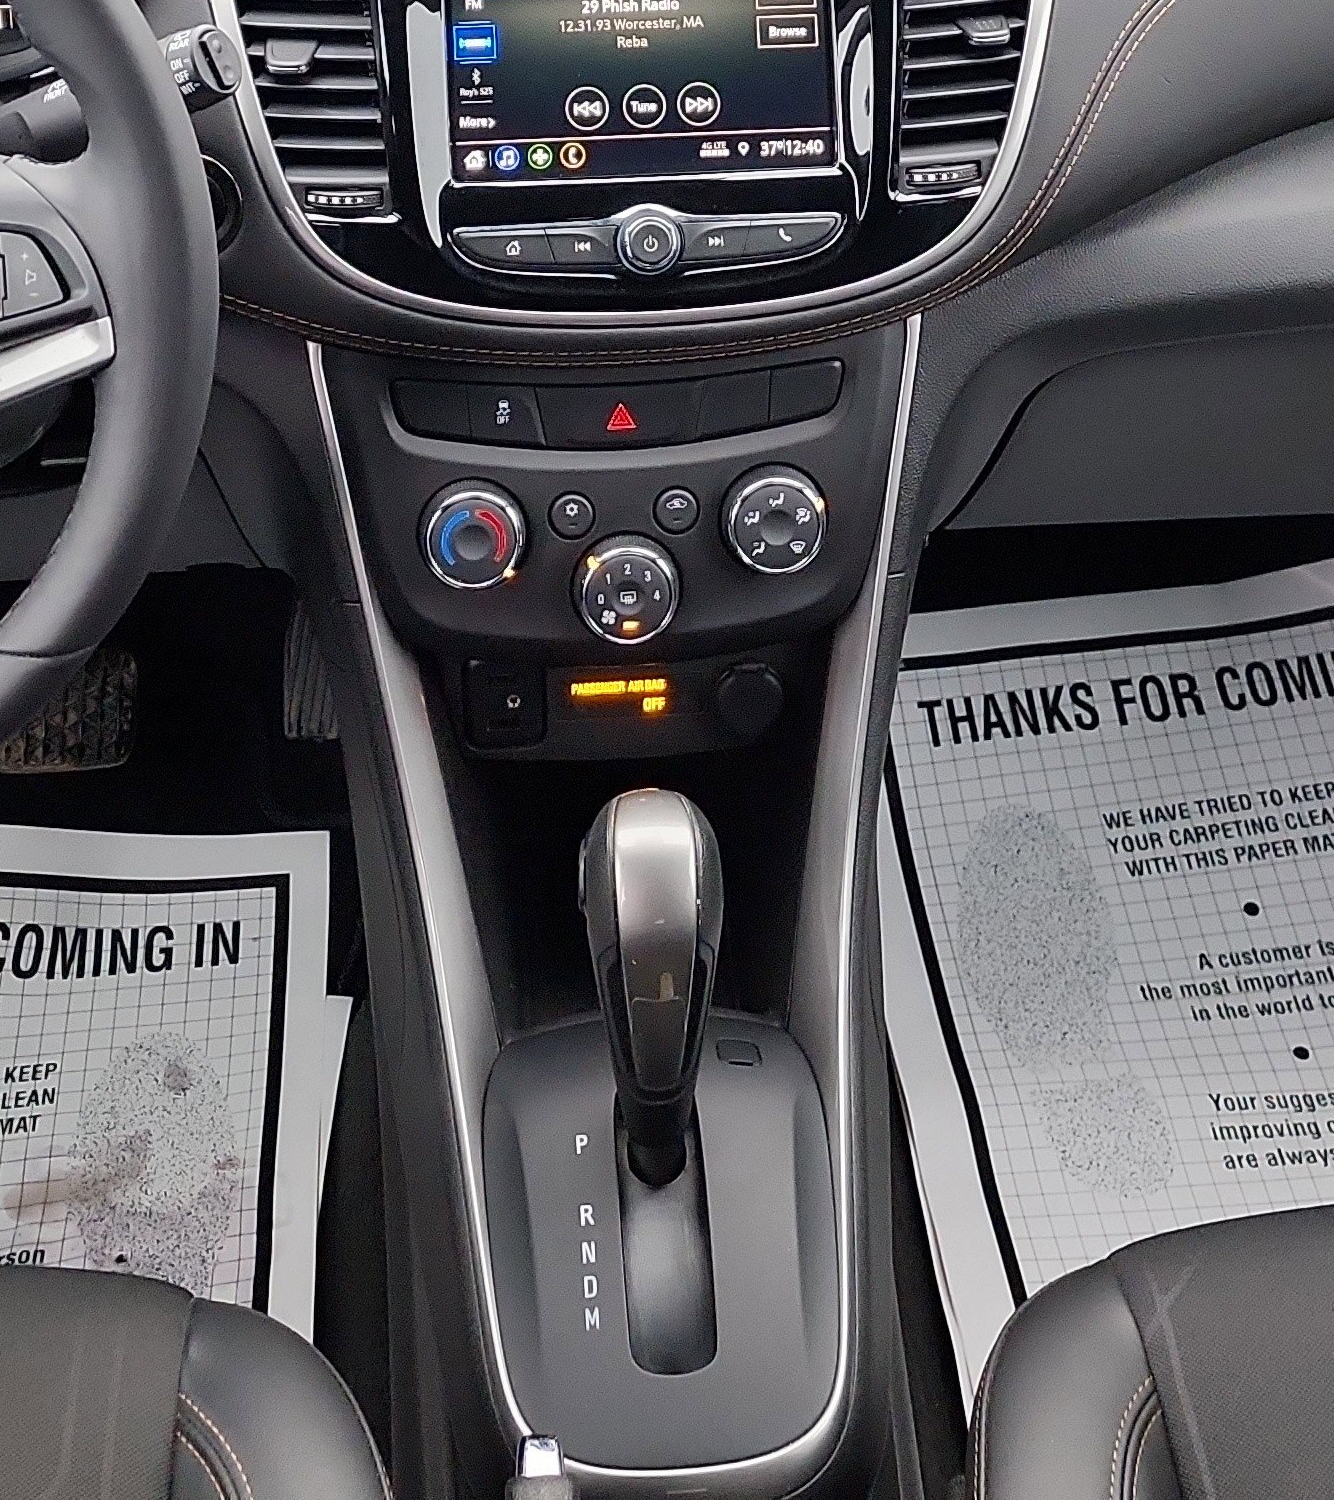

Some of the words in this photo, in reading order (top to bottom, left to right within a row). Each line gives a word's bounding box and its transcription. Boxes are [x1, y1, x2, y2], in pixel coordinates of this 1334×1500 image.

[465, 0, 483, 10] FM
[581, 0, 600, 14] 29
[559, 18, 611, 33] 12.31.93
[613, 16, 681, 31] Worcester,
[682, 16, 704, 28] MA
[768, 25, 808, 38] Browse
[616, 34, 648, 48] Reba
[629, 101, 658, 113] Tune
[785, 138, 824, 156] 12:40
[605, 573, 611, 585] 1
[624, 563, 632, 575] 2
[644, 570, 651, 582] 3
[653, 589, 661, 602] 4
[570, 680, 626, 697] PASSENGER
[627, 679, 644, 693] AIR
[642, 696, 666, 712] OFF
[917, 682, 1101, 749] THANKS
[1111, 672, 1206, 726] FOR
[1102, 810, 1136, 830] WE
[1139, 801, 1192, 826] HAVE
[1194, 793, 1253, 817] TRIED
[1256, 788, 1284, 808] TO
[1107, 831, 1164, 855] YOUR
[1168, 815, 1280, 847] CARPETING
[1124, 855, 1178, 877] WITH
[1182, 848, 1229, 871] THIS
[1233, 838, 1299, 864] PAPER
[194, 920, 242, 969] IN
[1198, 953, 1214, 971] A
[1218, 942, 1313, 968] customer
[1139, 983, 1173, 1001] the
[1178, 976, 1231, 999] most
[1190, 1004, 1212, 1022] in
[1216, 1002, 1250, 1021] the
[1255, 994, 1315, 1016] world
[3, 1062, 58, 1084] KEEP
[1208, 1093, 1258, 1112] Your
[1209, 1118, 1322, 1144] improving
[575, 1134, 589, 1155] P
[1223, 1151, 1260, 1170] are
[579, 1204, 595, 1226] R
[581, 1240, 597, 1264] N
[583, 1275, 598, 1299] D
[584, 1306, 600, 1331] M
